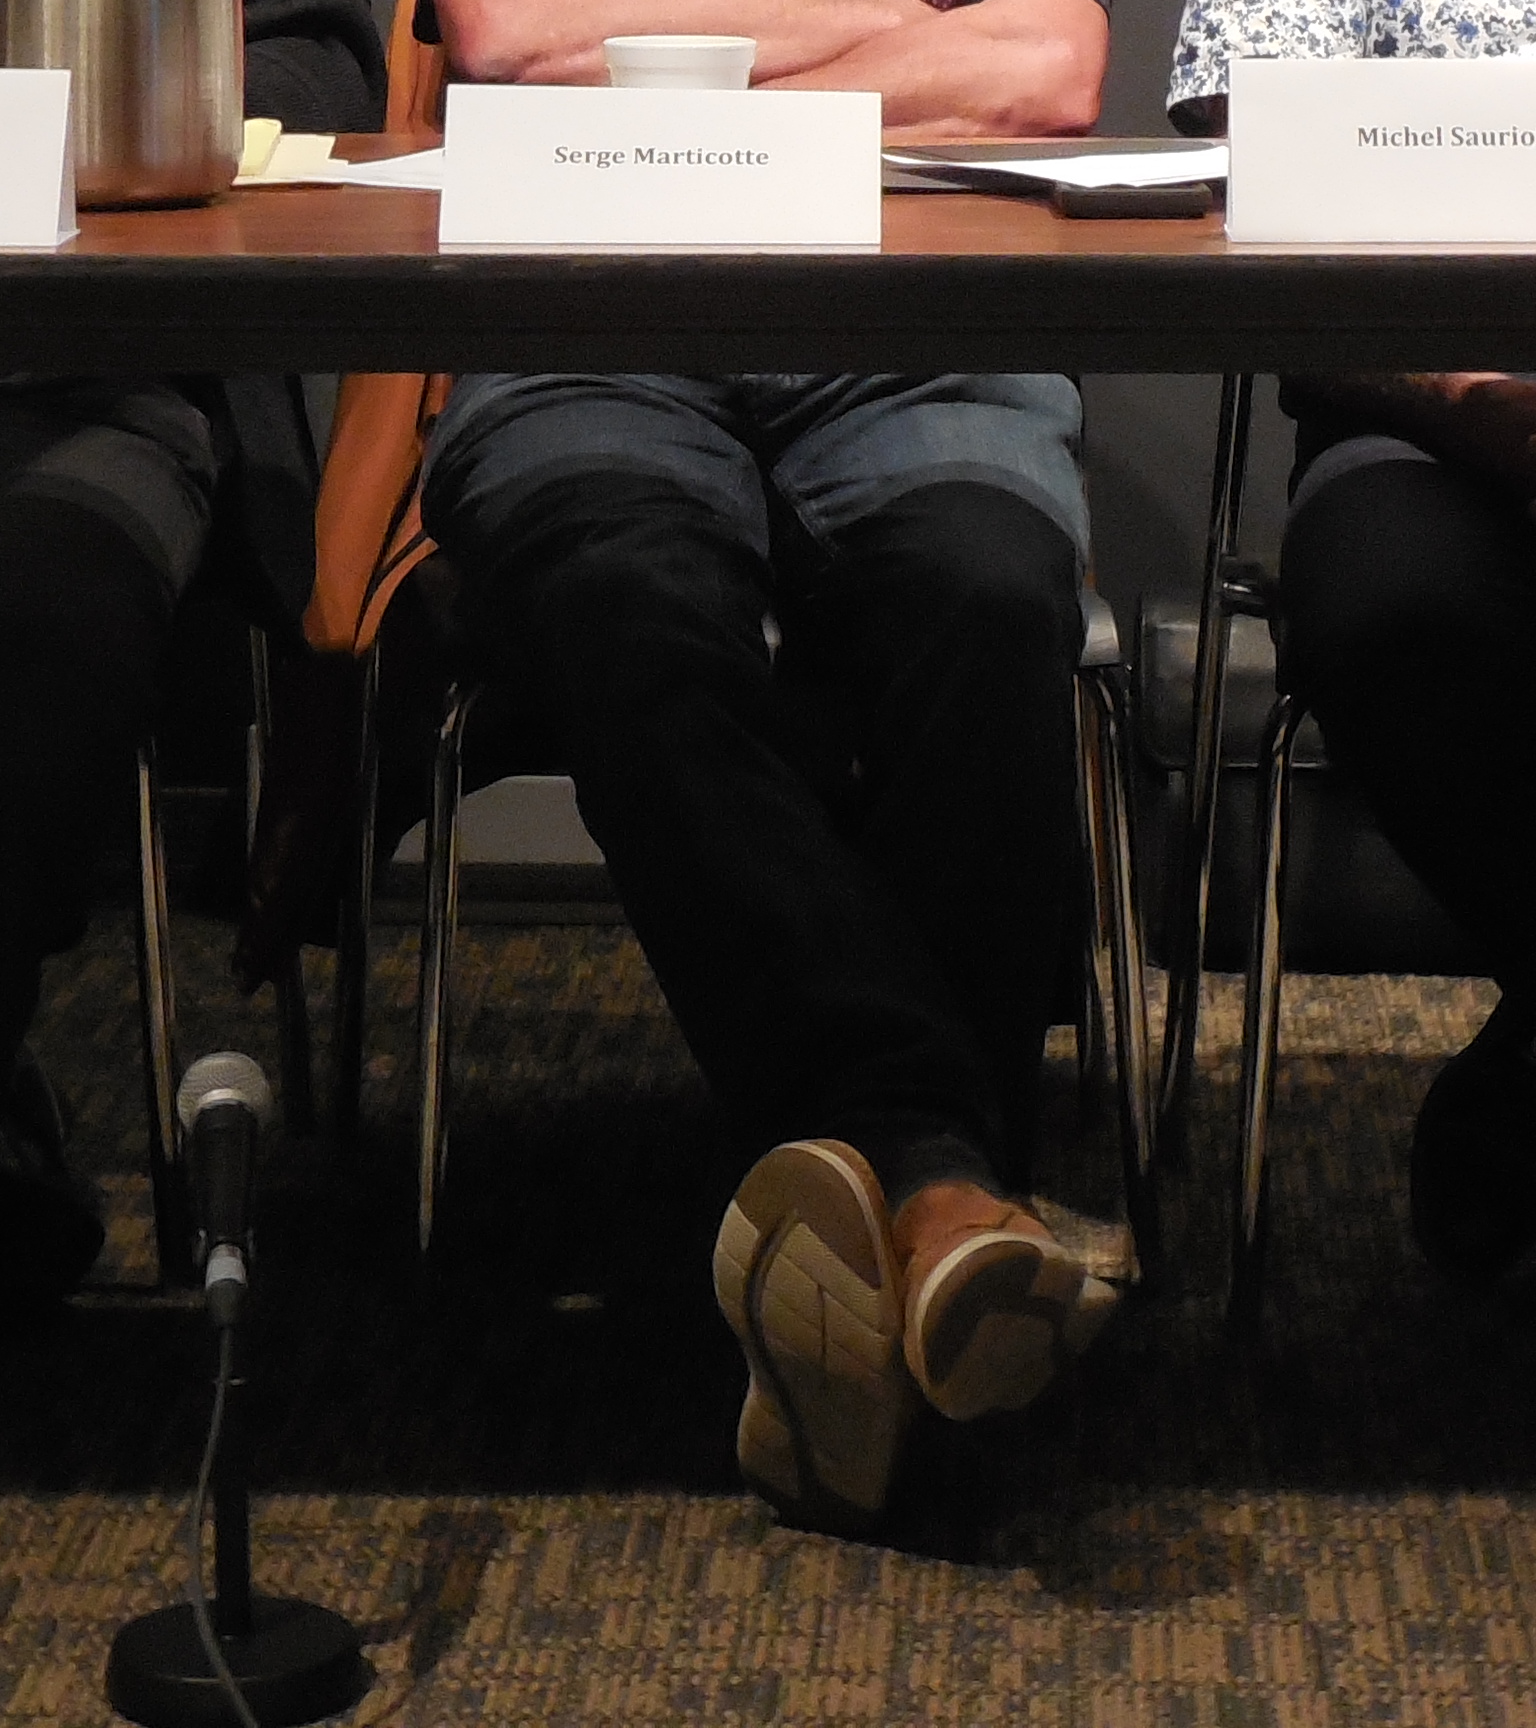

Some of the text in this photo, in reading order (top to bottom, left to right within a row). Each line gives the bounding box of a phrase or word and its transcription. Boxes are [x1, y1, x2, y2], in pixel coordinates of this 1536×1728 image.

[1356, 124, 1443, 148] Michel
[553, 145, 770, 170] Serge Marticotte
